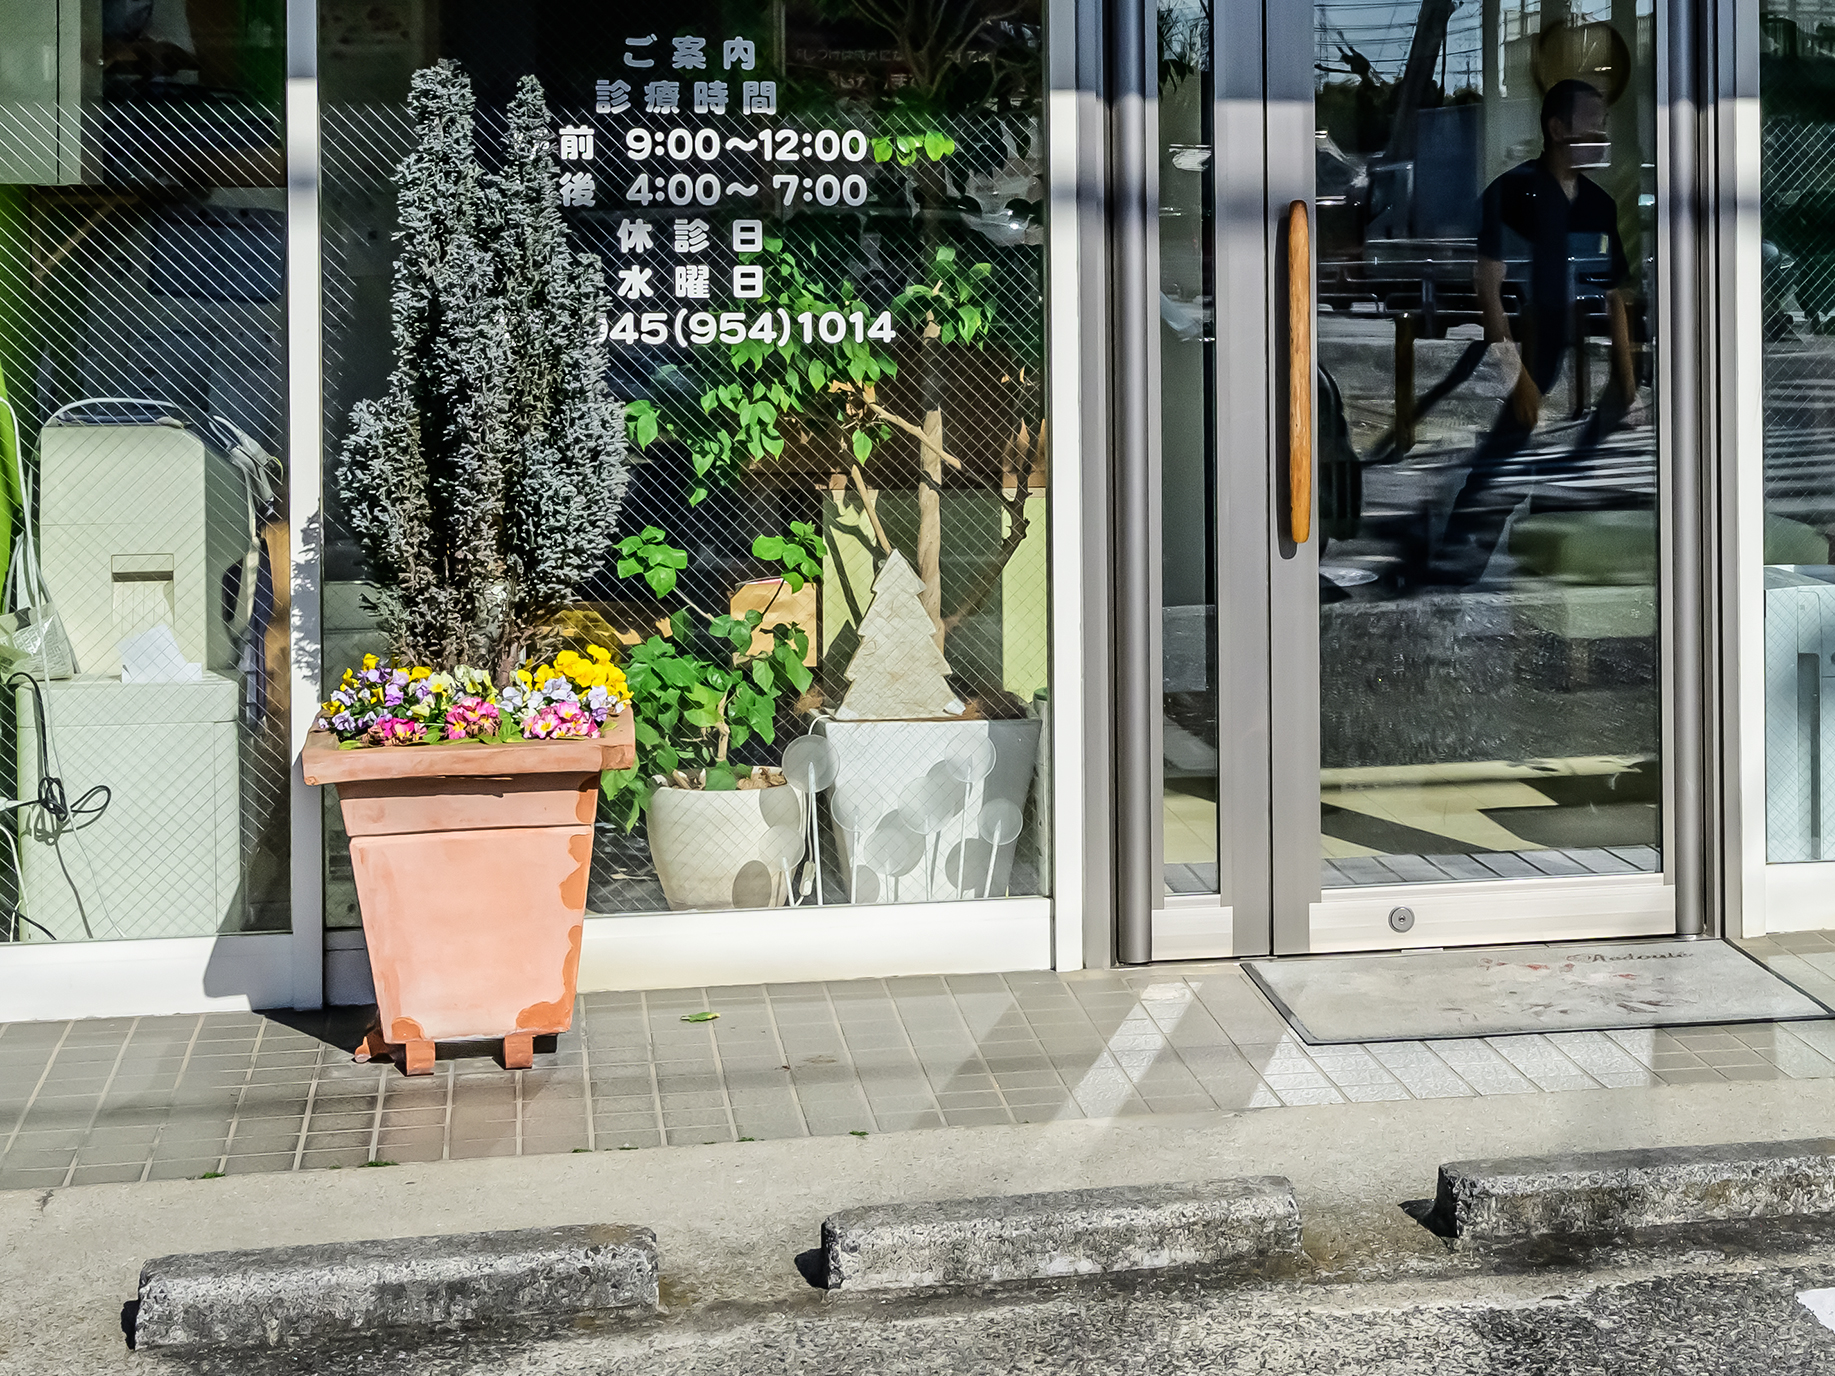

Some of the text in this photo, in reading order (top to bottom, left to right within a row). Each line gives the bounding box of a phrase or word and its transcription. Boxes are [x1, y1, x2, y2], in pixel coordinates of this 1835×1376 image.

[624, 32, 756, 70] ご案内
[595, 79, 777, 116] 診療時間
[616, 218, 764, 253] 休診日
[617, 265, 764, 300] 水曜日
